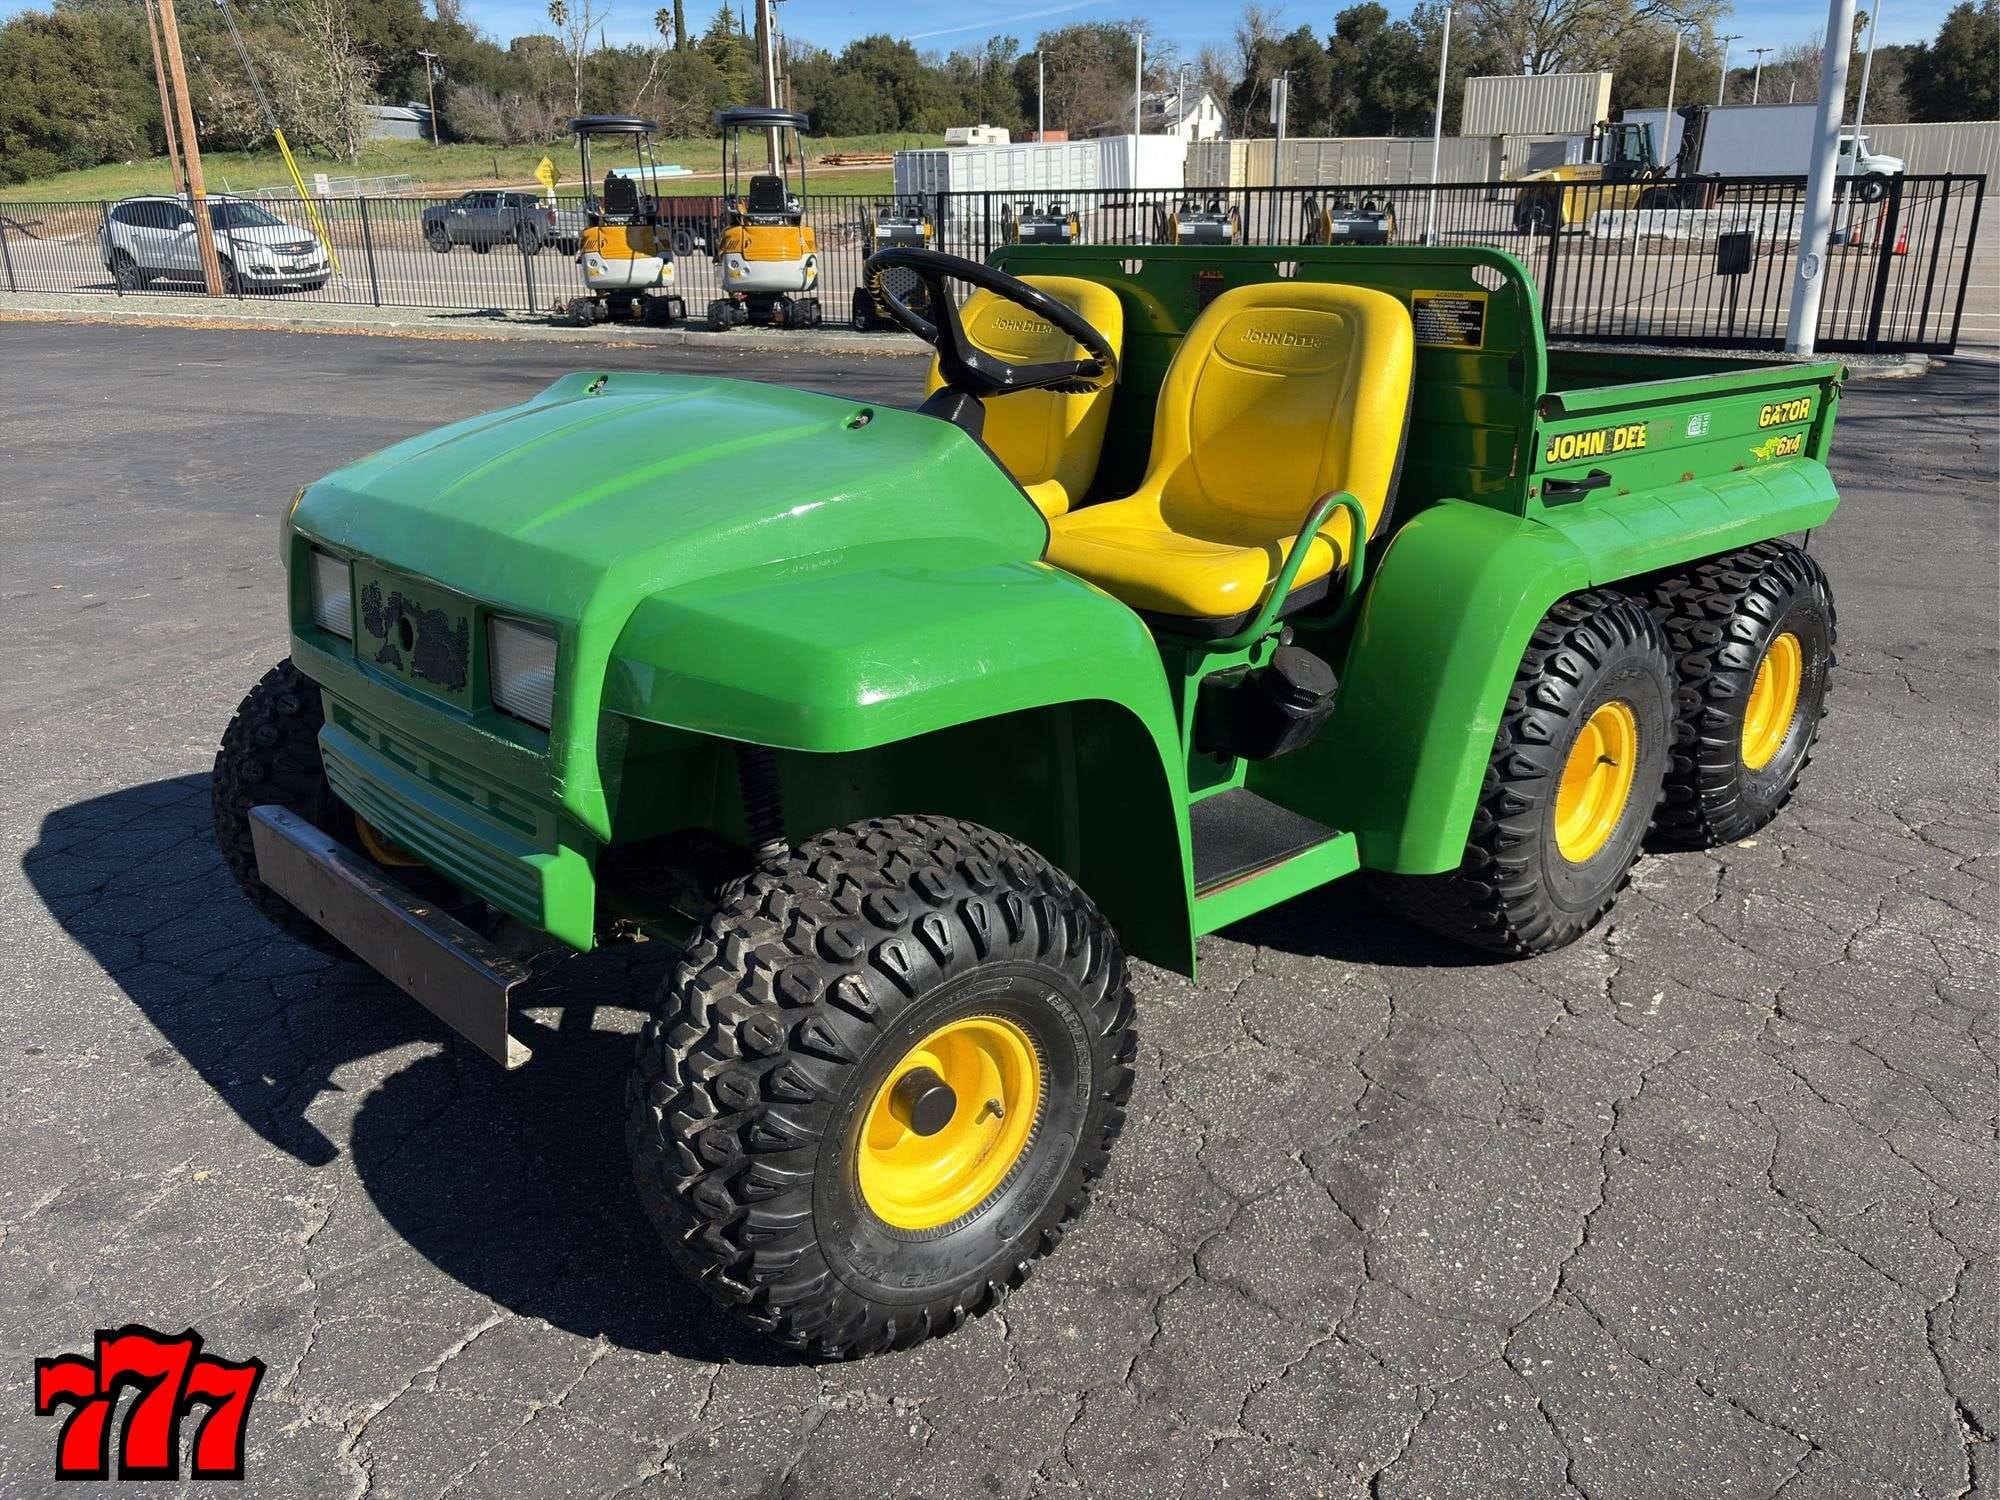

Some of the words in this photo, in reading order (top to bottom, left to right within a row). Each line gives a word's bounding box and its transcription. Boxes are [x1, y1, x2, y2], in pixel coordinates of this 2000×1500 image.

[991, 316, 1021, 331] JOHN
[1240, 328, 1281, 346] JOHN
[1759, 397, 1811, 428] GATOR
[1546, 431, 1607, 463] JOHN
